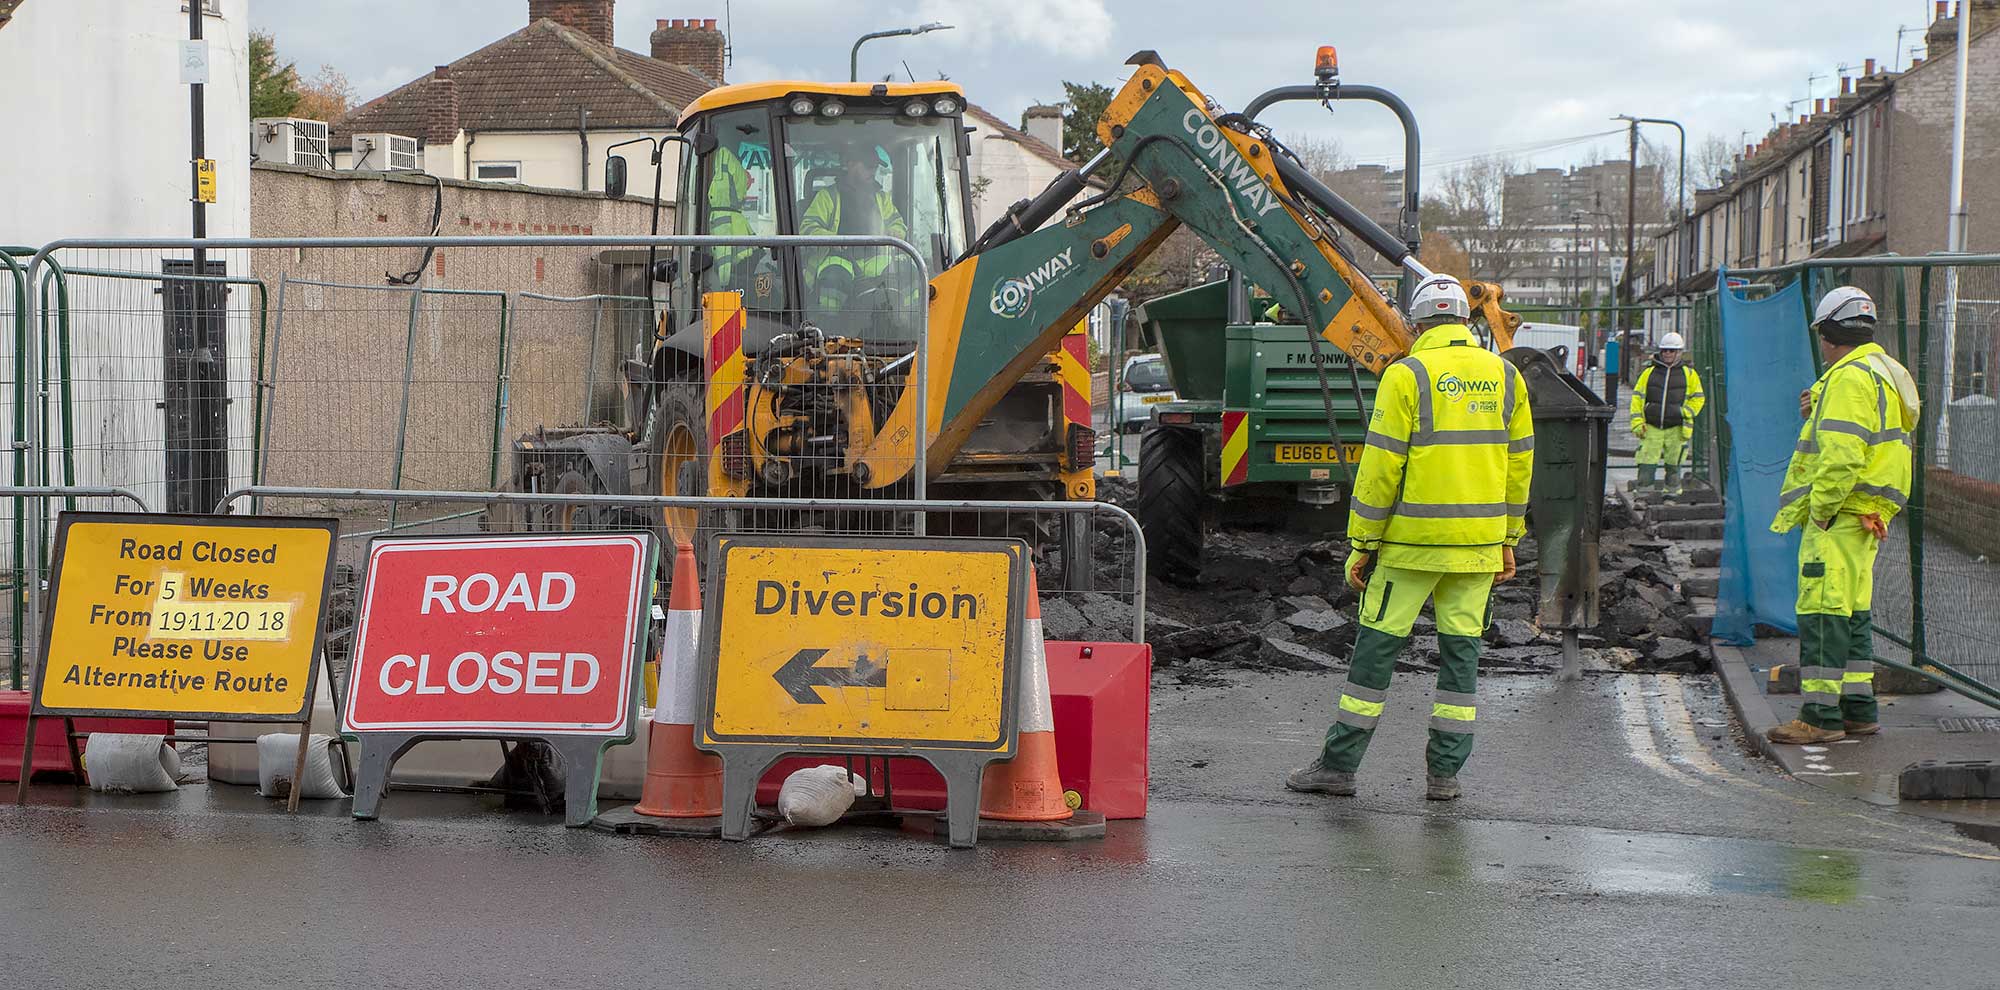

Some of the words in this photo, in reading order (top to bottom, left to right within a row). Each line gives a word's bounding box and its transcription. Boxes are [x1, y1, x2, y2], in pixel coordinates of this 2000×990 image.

[1183, 108, 1281, 217] CONWAY
[990, 246, 1073, 315] CONWAY
[1287, 353, 1294, 364] F
[1297, 353, 1306, 364] M
[1436, 380, 1499, 393] CONWAY
[1282, 446, 1322, 460] EU66
[119, 538, 183, 561] Road
[192, 541, 278, 564] Closed
[114, 574, 155, 596] For
[162, 581, 176, 600] 5
[190, 577, 270, 599] Weeks
[420, 571, 577, 615] ROAD
[754, 579, 979, 621] Diversion
[89, 604, 151, 626] From
[257, 611, 285, 631] 18
[112, 636, 194, 660] Please
[203, 639, 250, 661] Use
[63, 664, 206, 691] Alternative
[214, 670, 289, 694] Route
[378, 651, 601, 696] CLOSED
